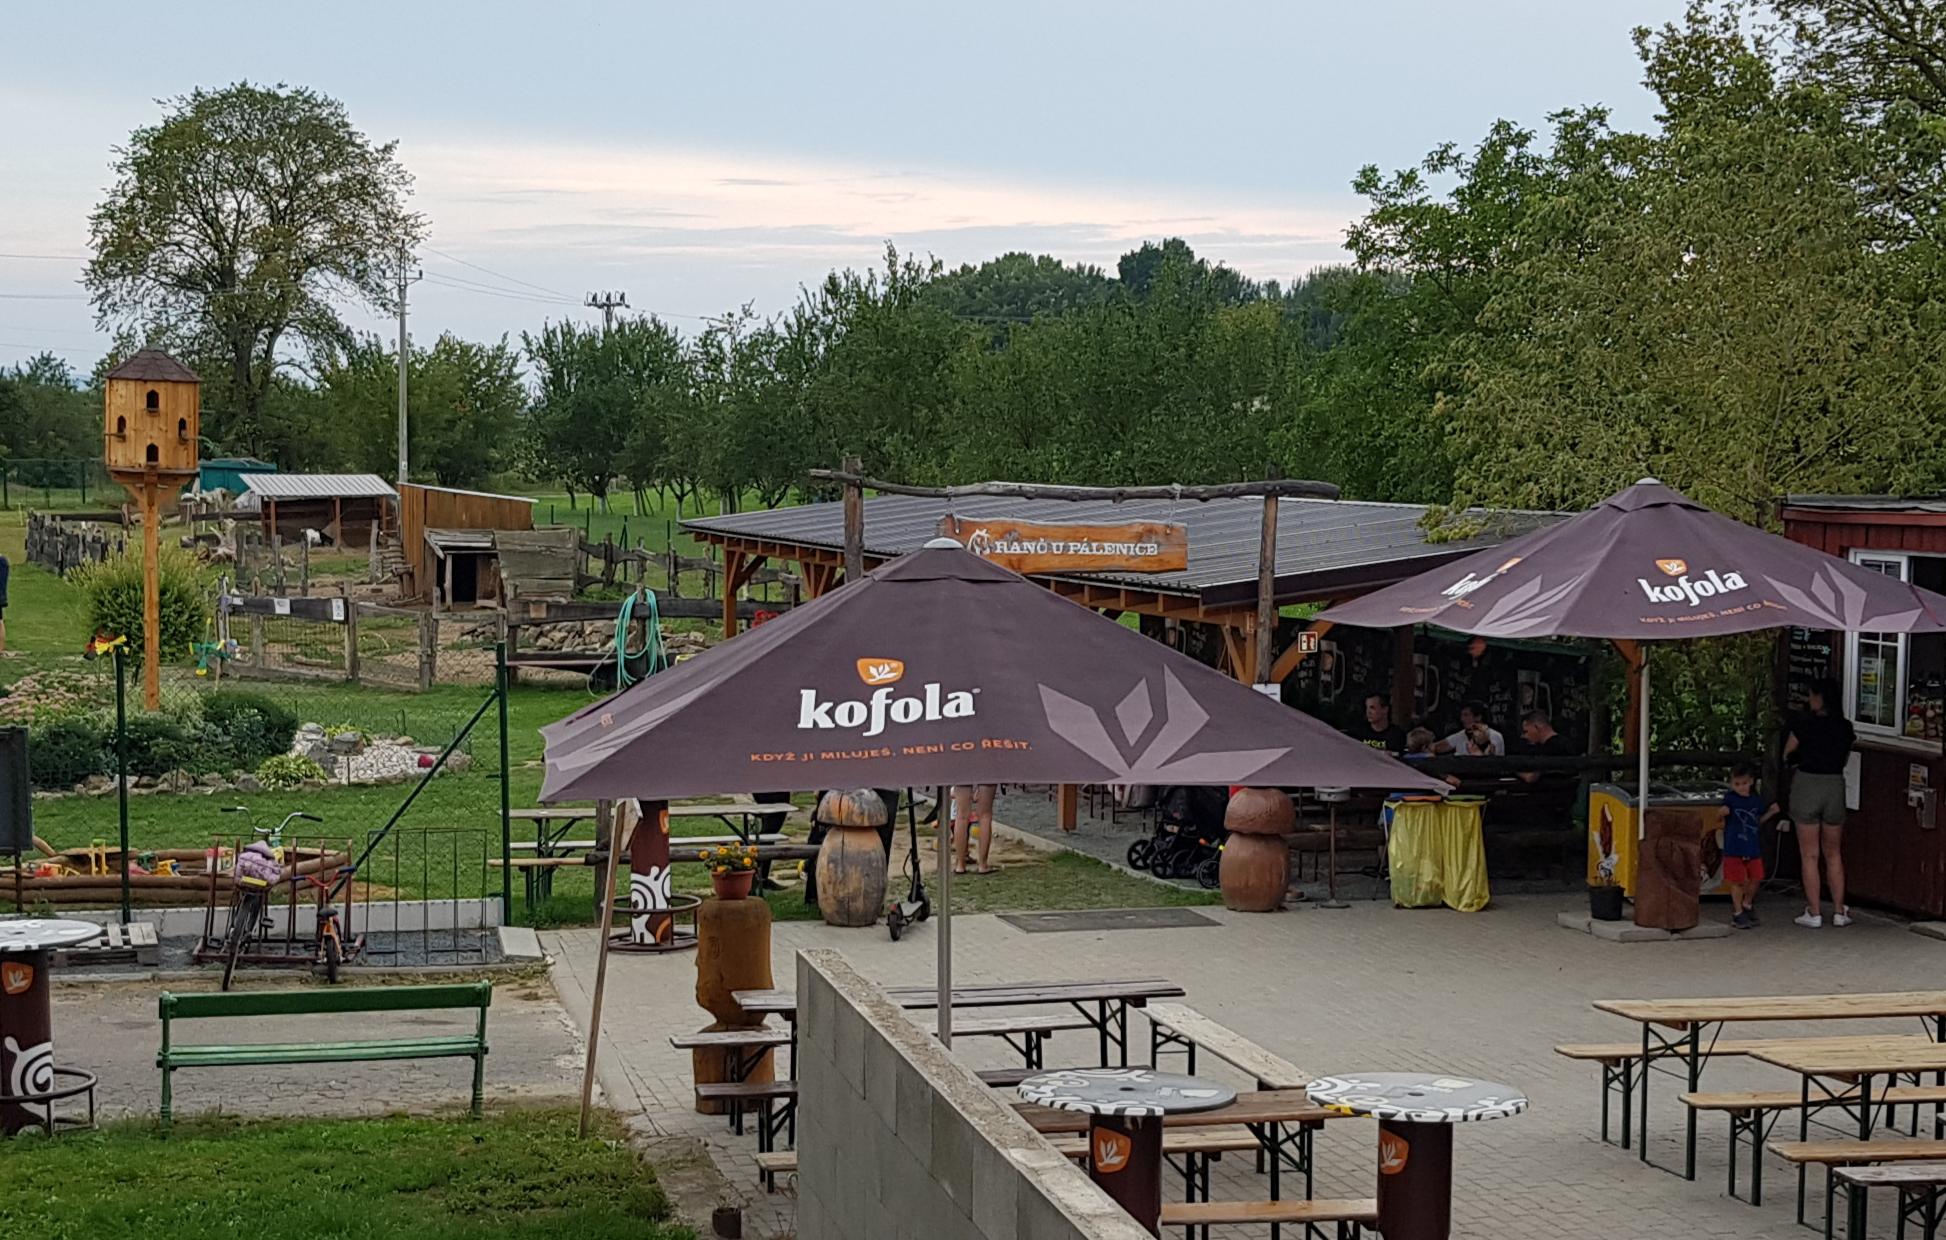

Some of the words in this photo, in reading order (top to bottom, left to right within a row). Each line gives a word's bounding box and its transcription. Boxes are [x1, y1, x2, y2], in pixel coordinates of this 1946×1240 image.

[1051, 542, 1065, 555] U
[1067, 537, 1158, 556] PÁLENICE
[1637, 569, 1748, 607] kofola
[797, 683, 976, 737] kofola
[750, 751, 796, 762] KDYŽ
[800, 752, 815, 762] JI
[902, 743, 945, 755] NENÍ
[950, 741, 975, 752] CO
